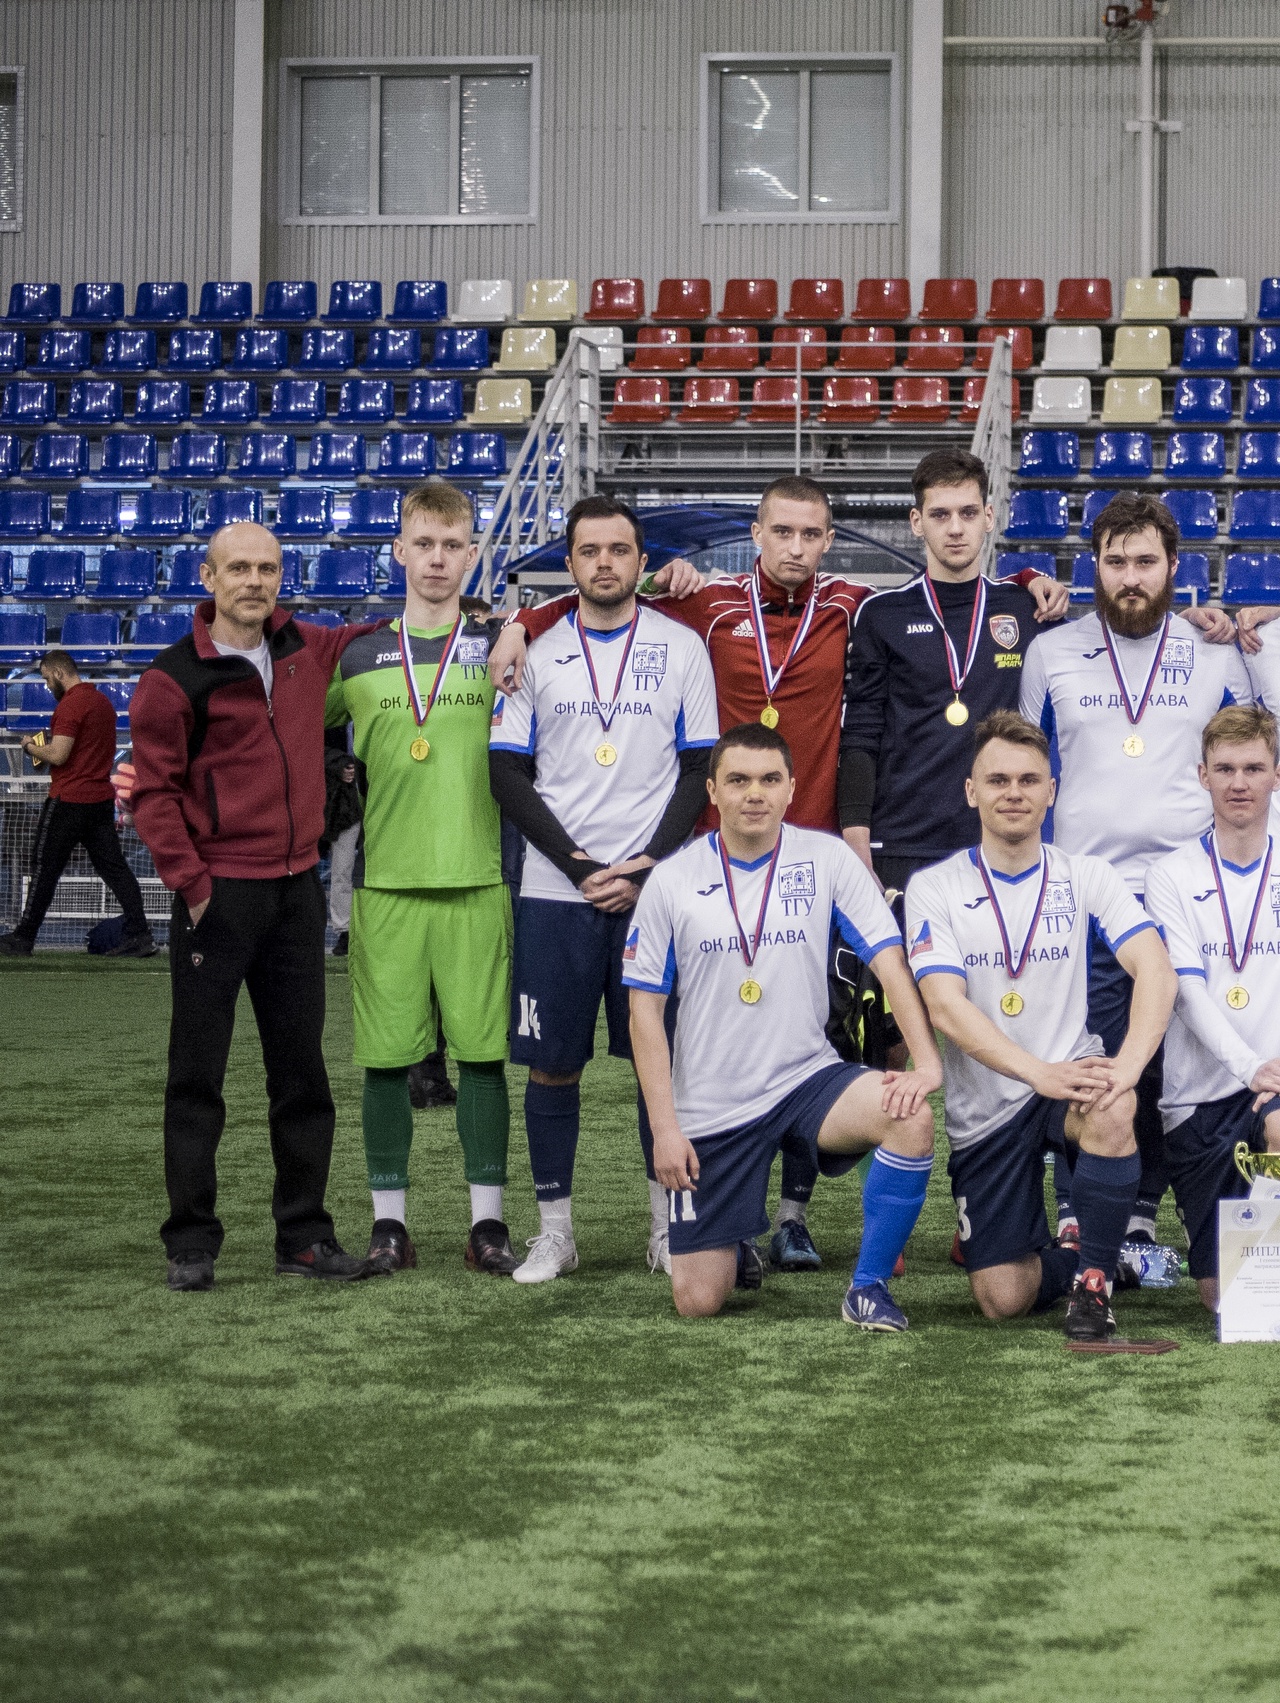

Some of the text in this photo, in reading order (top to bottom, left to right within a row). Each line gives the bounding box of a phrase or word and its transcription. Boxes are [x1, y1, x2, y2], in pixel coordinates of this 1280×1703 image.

[906, 624, 934, 634] JAKO
[460, 664, 488, 680] ТГУ
[1161, 668, 1192, 685] ТГУ
[633, 674, 664, 692] ТГУ
[380, 696, 402, 711] ФК
[554, 701, 577, 715] ФК
[1079, 694, 1103, 707] ФК
[781, 897, 815, 916] ТГУ
[1042, 914, 1076, 934] ТГУ
[699, 937, 724, 954] ФК
[965, 951, 989, 967] ФК
